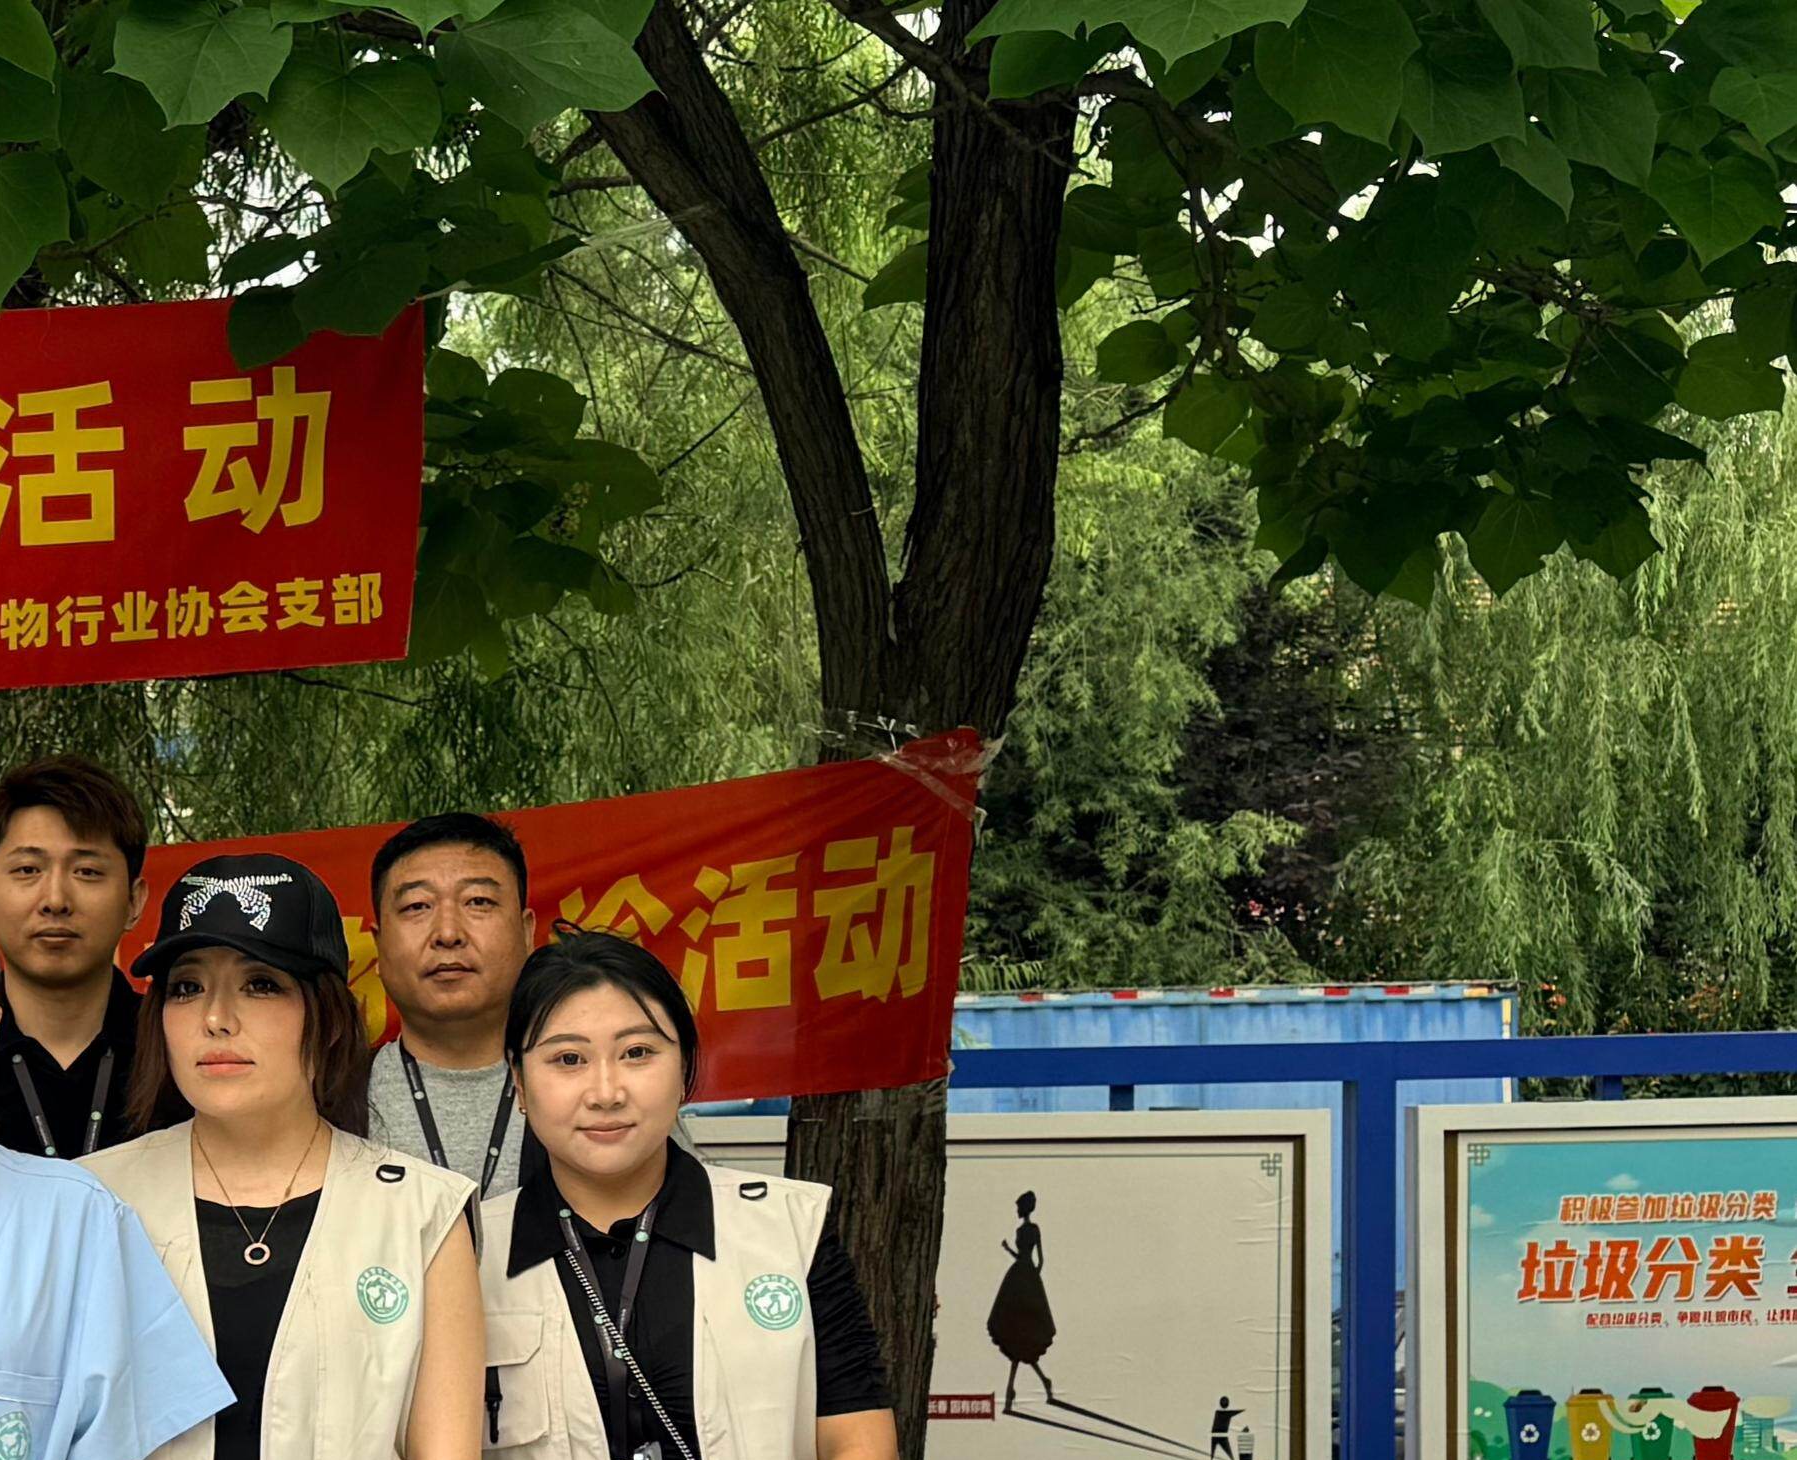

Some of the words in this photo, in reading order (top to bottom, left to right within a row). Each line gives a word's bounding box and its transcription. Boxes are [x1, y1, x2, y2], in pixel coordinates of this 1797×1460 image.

[1560, 1191, 1777, 1223] 积极参加垃圾分类
[1517, 1235, 1764, 1302] 垃圾分类
